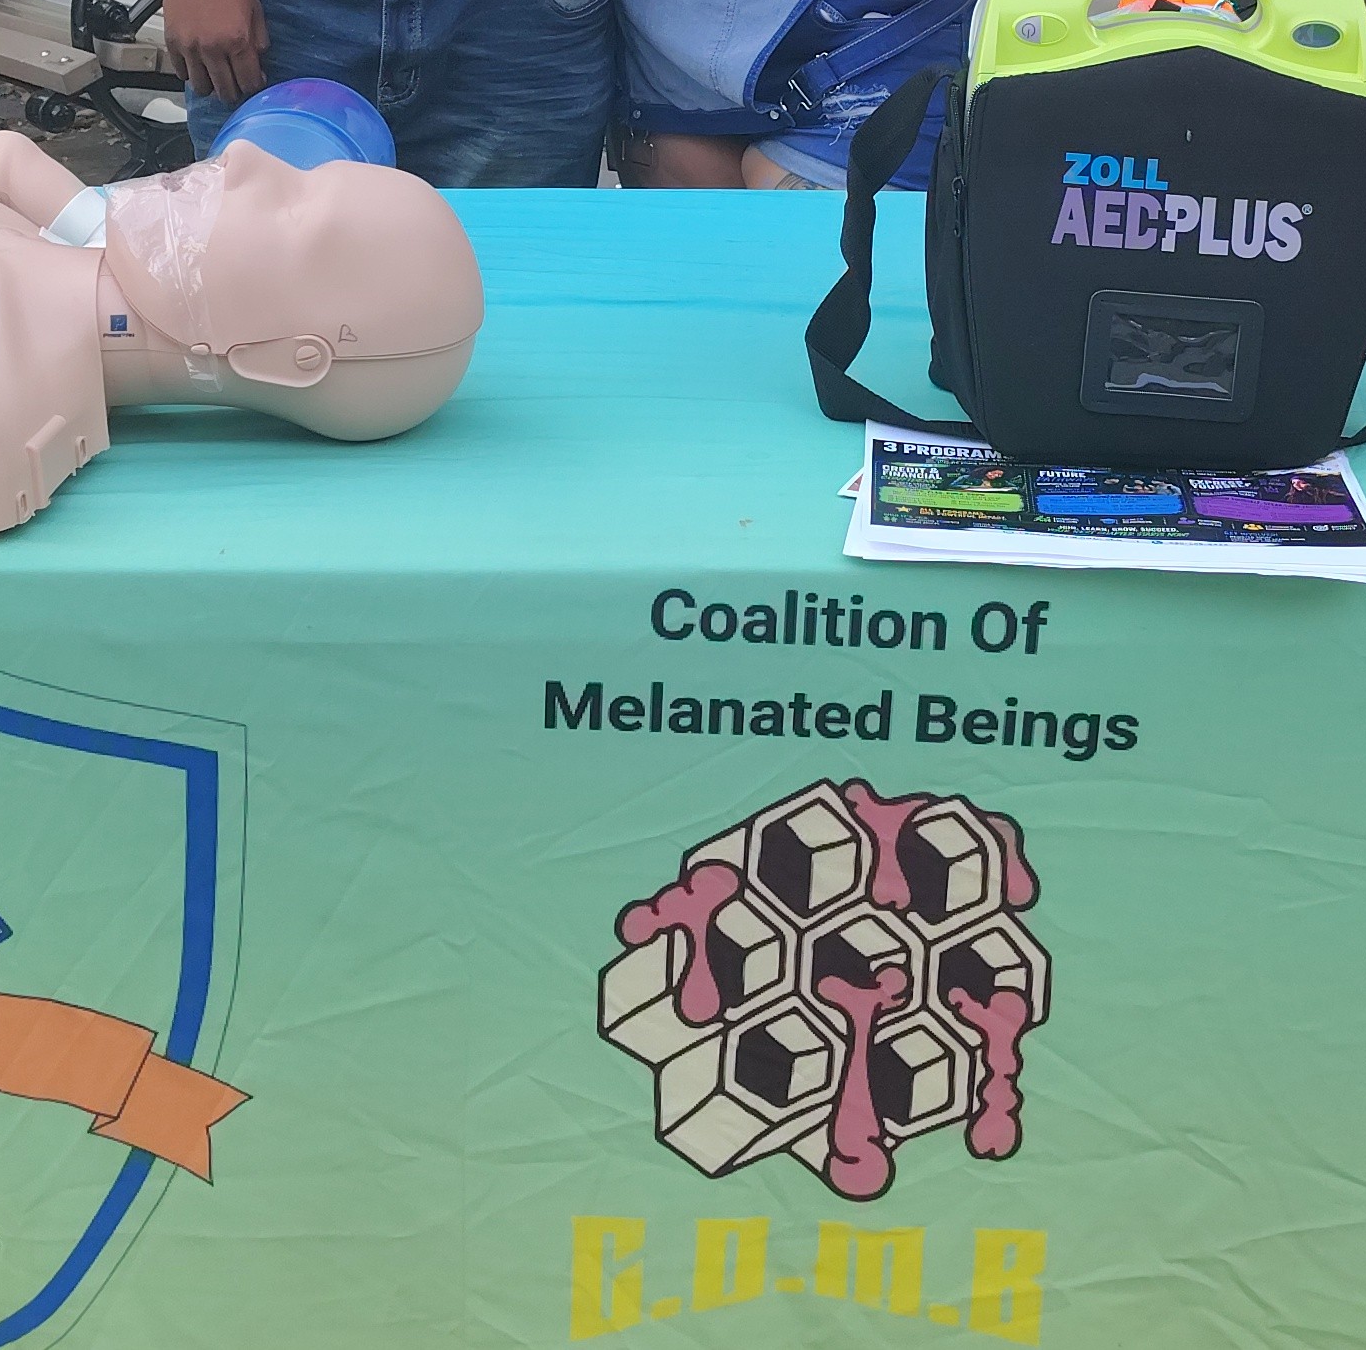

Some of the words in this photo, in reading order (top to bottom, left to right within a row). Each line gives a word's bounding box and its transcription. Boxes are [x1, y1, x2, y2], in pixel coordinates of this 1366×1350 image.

[1062, 152, 1169, 191] ZOLL
[883, 442, 897, 452] 3
[882, 470, 942, 480] FINANCIAL
[1039, 470, 1086, 478] FUTURE
[650, 588, 948, 650] Coalition
[970, 601, 1050, 654] Of
[543, 681, 893, 742] Melanated
[915, 693, 1139, 762] Beings
